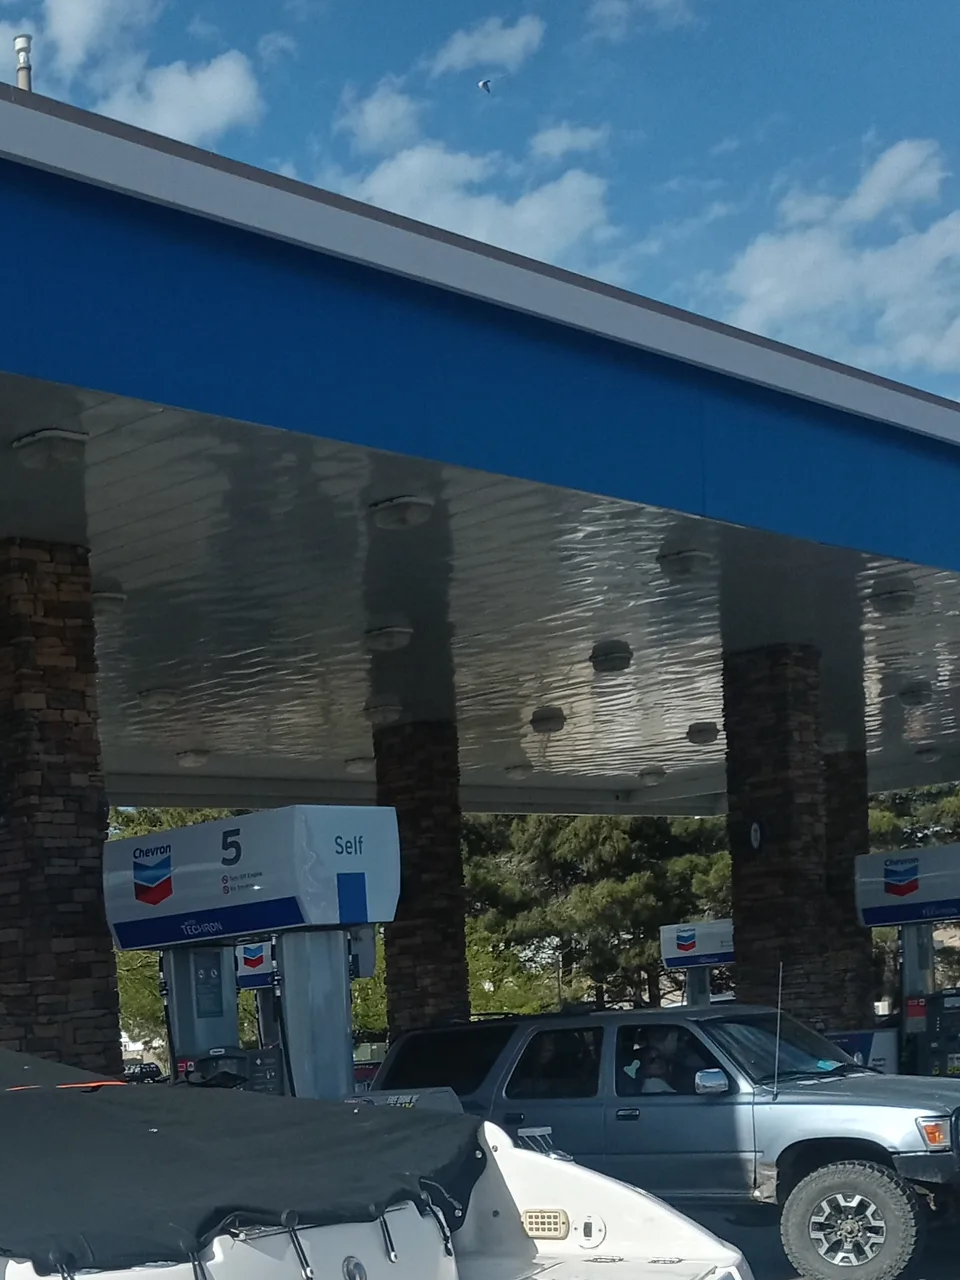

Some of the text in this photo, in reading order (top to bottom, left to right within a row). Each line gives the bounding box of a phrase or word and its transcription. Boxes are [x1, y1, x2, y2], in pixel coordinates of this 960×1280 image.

[133, 844, 171, 859] Chevron
[221, 828, 242, 866] 5
[334, 835, 363, 855] Self
[181, 921, 223, 935] TECHRON
